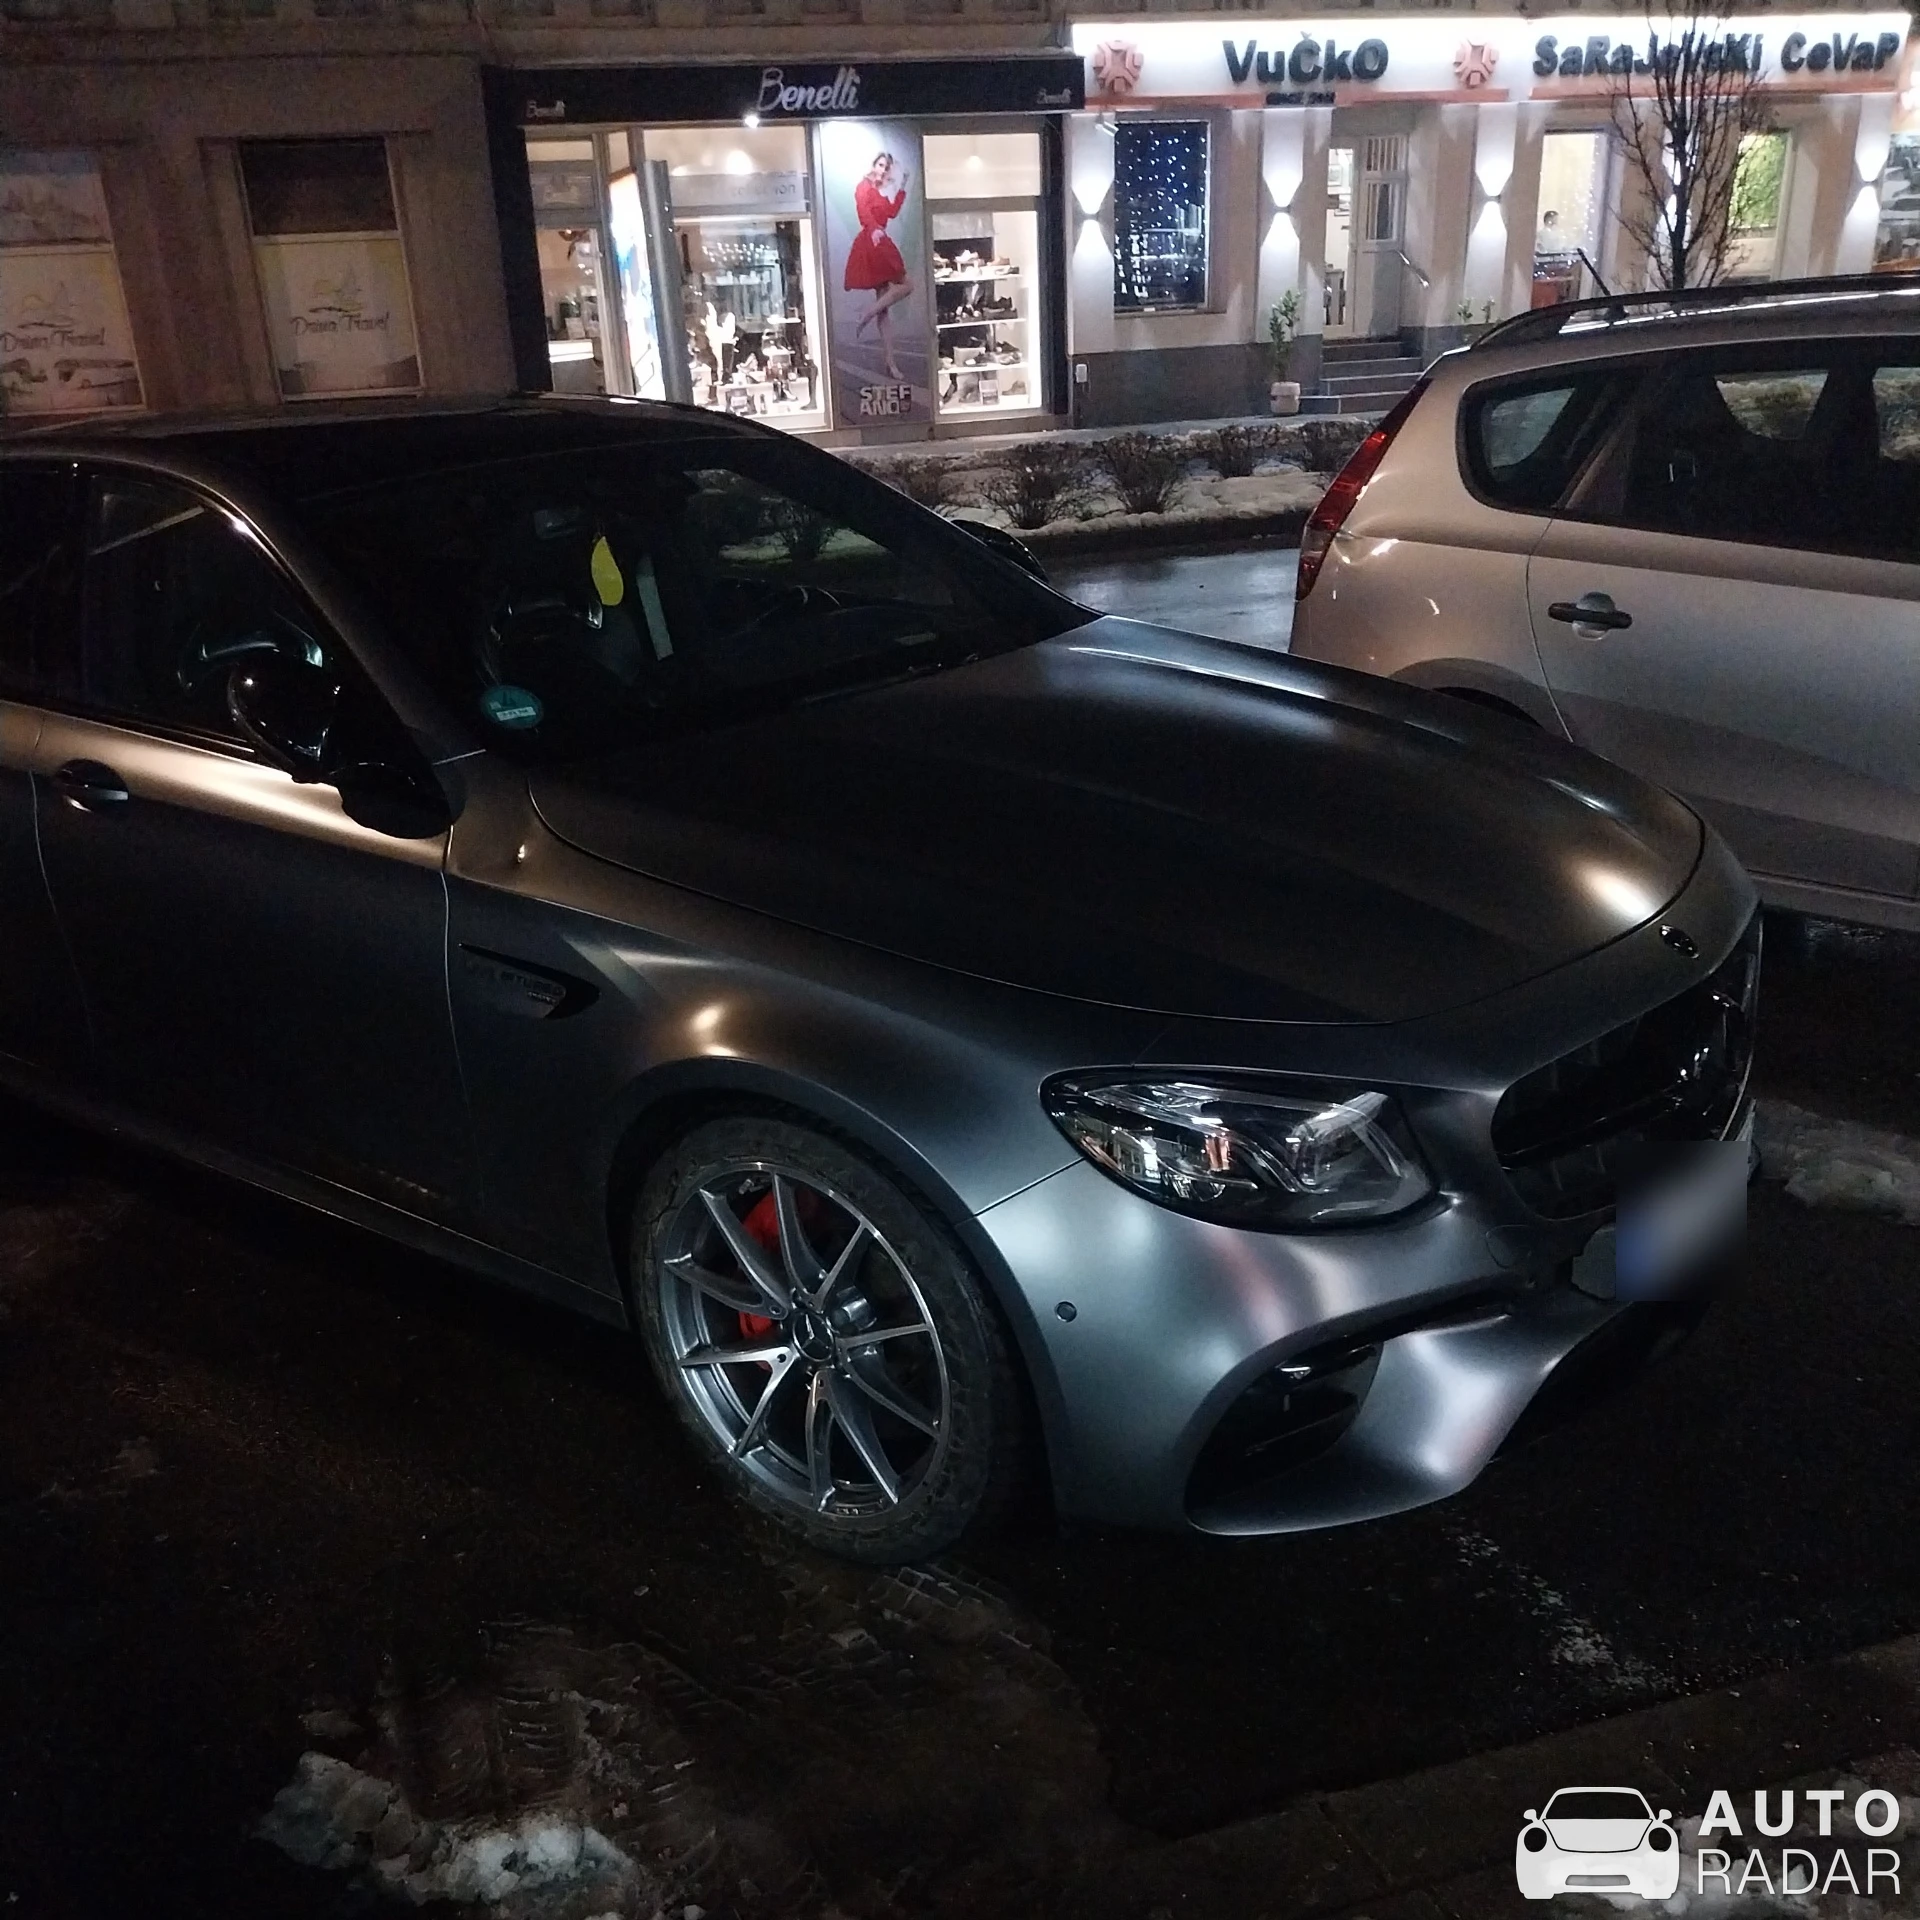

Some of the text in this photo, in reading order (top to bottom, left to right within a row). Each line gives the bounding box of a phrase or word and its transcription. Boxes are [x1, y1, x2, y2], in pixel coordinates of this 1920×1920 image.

[757, 66, 860, 111] Benelli
[860, 385, 910, 402] STEF
[860, 400, 899, 416] ANO
